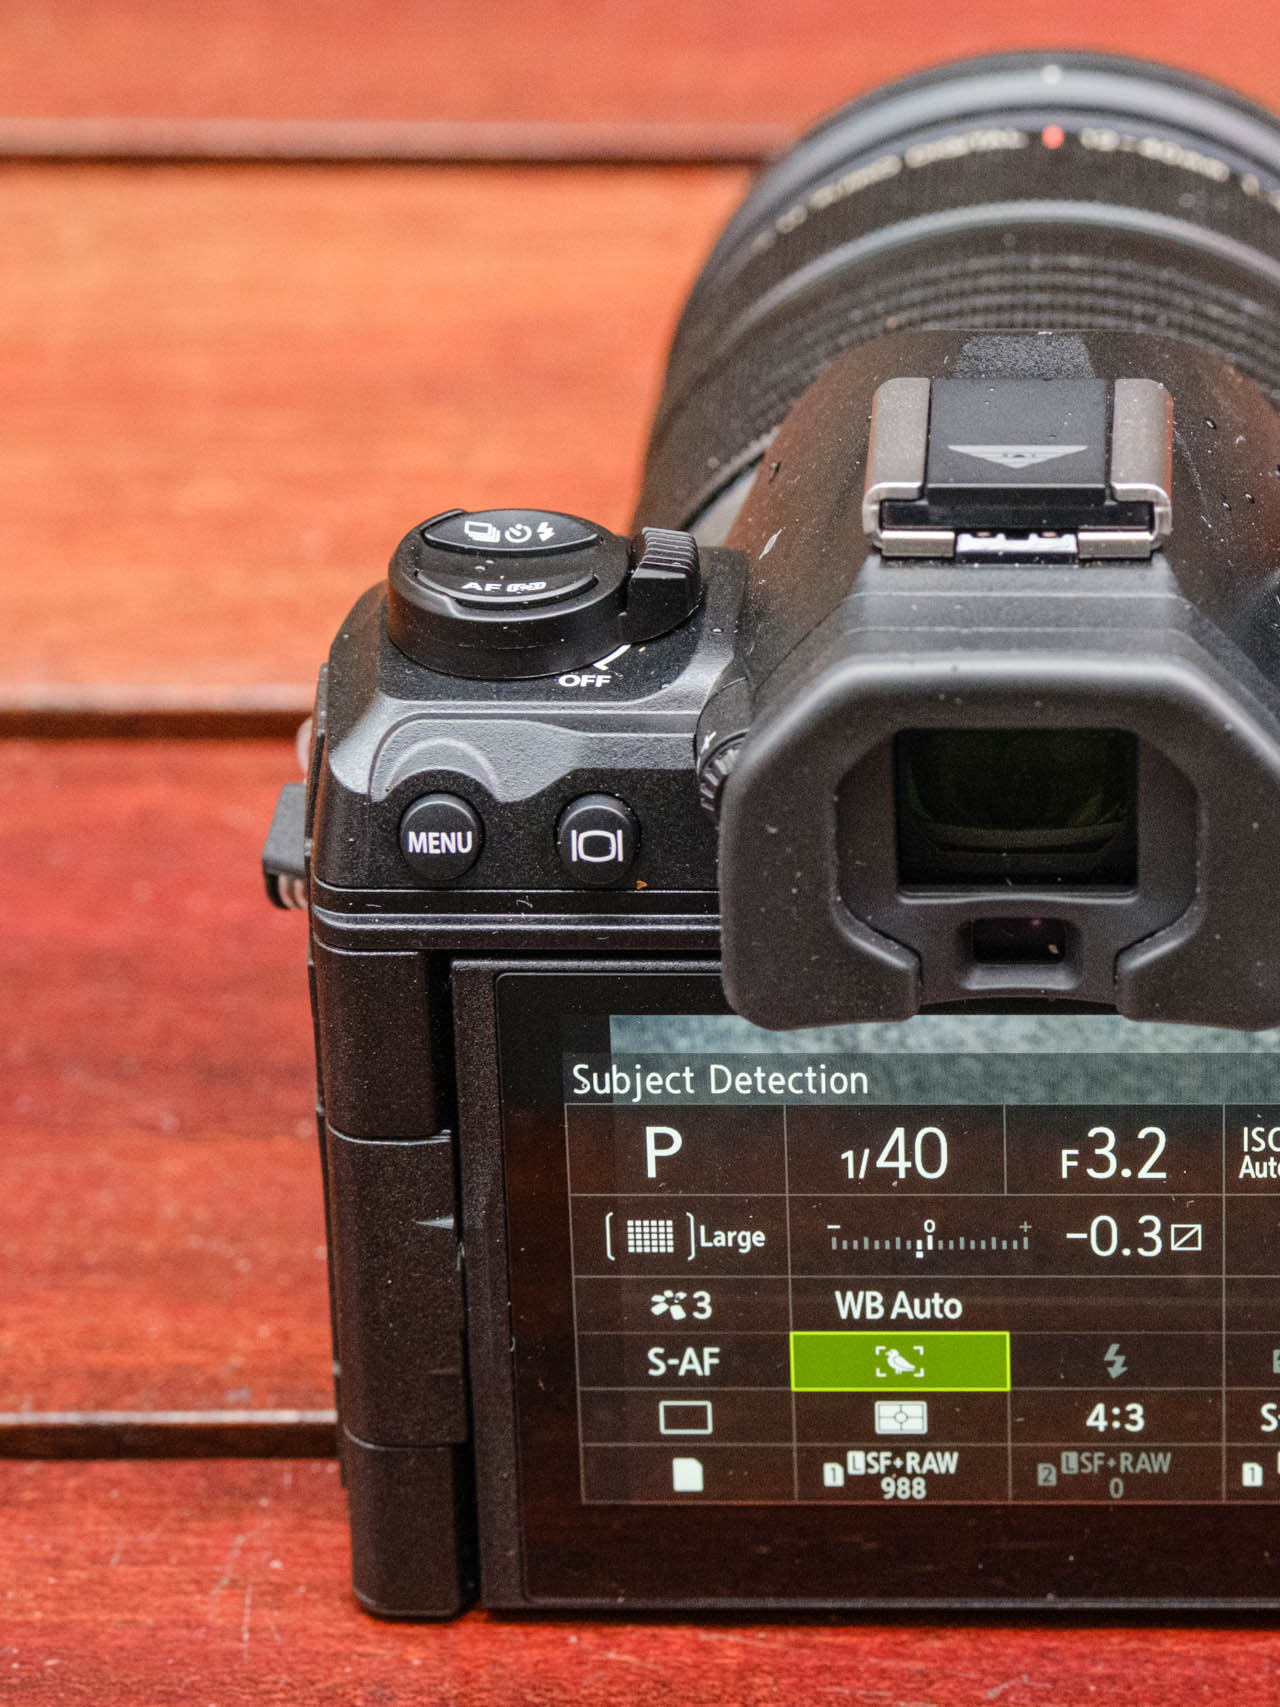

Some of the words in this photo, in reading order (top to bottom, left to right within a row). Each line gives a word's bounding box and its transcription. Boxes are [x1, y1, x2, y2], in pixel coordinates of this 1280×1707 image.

[461, 582, 502, 592] AF
[558, 674, 612, 687] OFF
[408, 831, 473, 854] MENU
[572, 1064, 695, 1103] Subject
[710, 1064, 869, 1095] Detection
[645, 1126, 683, 1178] P
[840, 1127, 949, 1179] 1/40
[1061, 1126, 1168, 1179] F3.2
[699, 1225, 766, 1254] Large
[1066, 1215, 1163, 1257] -0.3
[692, 1292, 712, 1320] 3
[834, 1291, 884, 1320] WB
[890, 1291, 963, 1320] Auto
[647, 1347, 720, 1376] S-AF
[1086, 1403, 1144, 1432] 4:3
[881, 1477, 926, 1500] 988
[1109, 1478, 1124, 1499] 0
